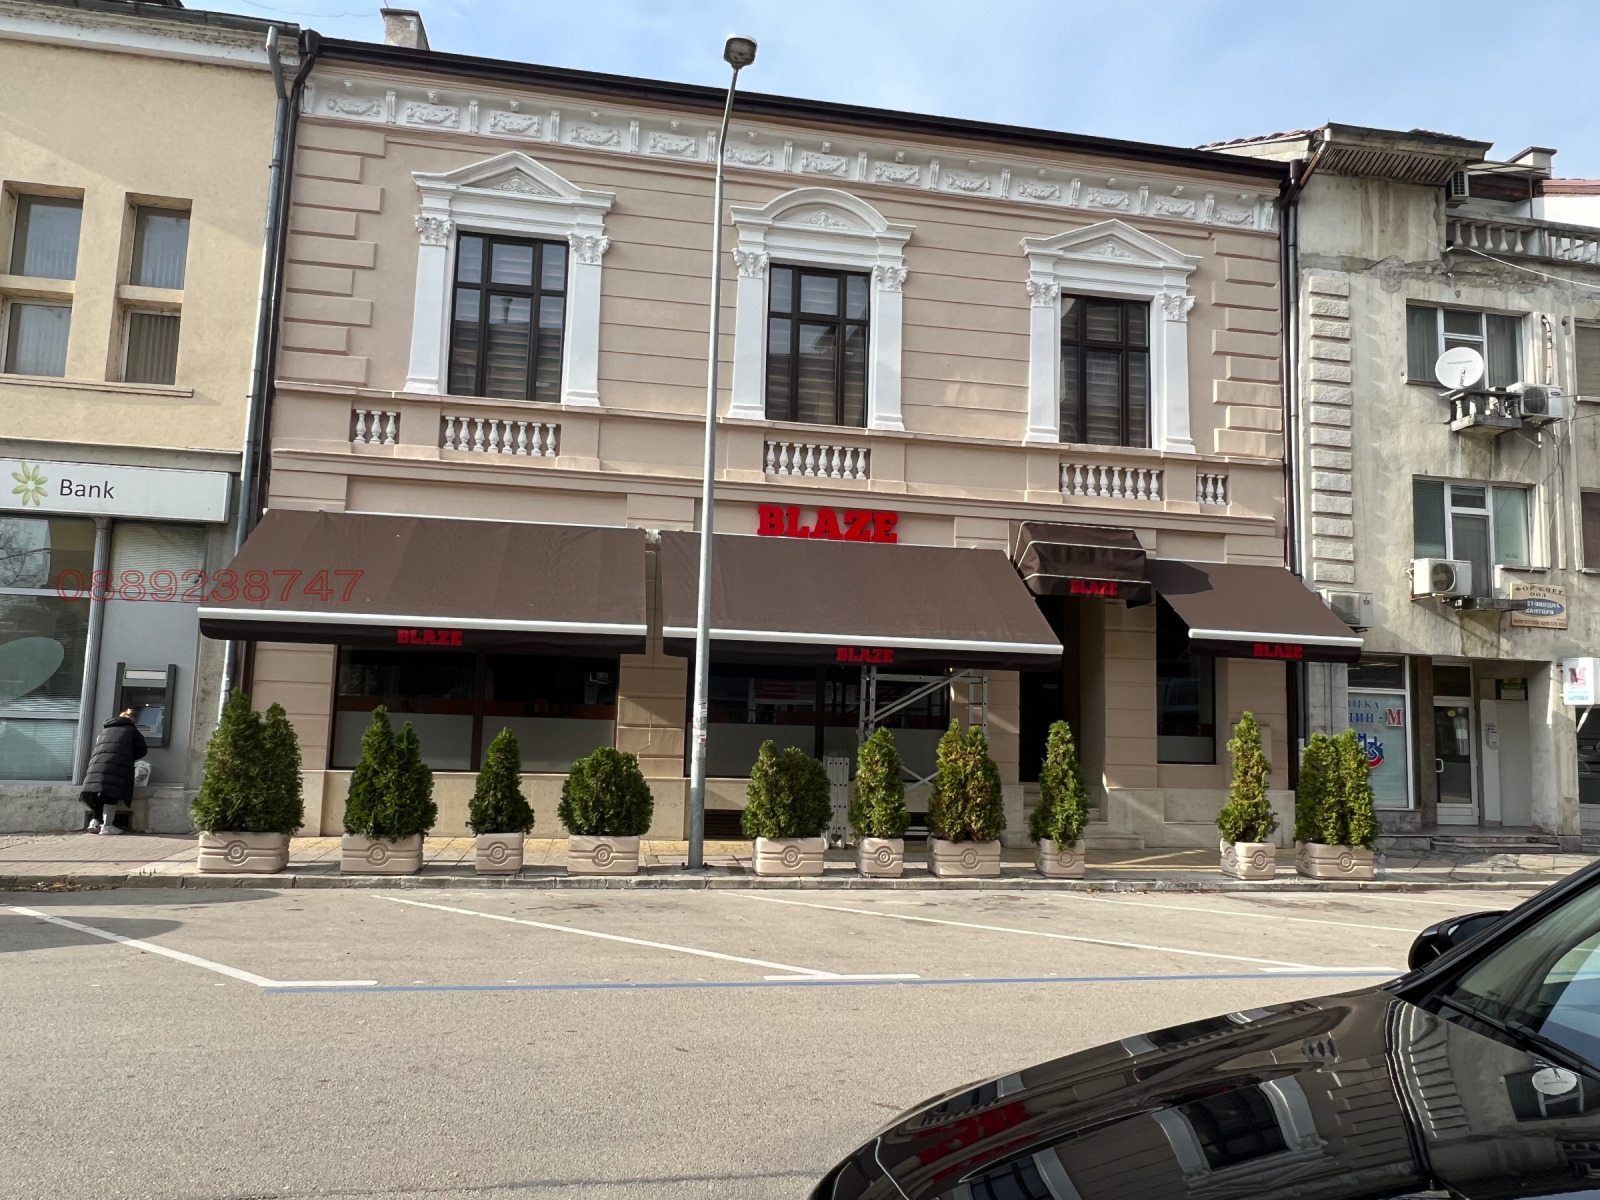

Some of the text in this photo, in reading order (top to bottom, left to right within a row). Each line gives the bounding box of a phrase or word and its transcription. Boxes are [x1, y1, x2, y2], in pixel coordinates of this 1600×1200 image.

[60, 478, 115, 500] Bank
[757, 504, 898, 544] BLAZE
[1069, 580, 1118, 595] BLAZE
[397, 629, 463, 646] BLAZE
[836, 647, 894, 663] BLAZE
[1253, 643, 1303, 658] BLAZE
